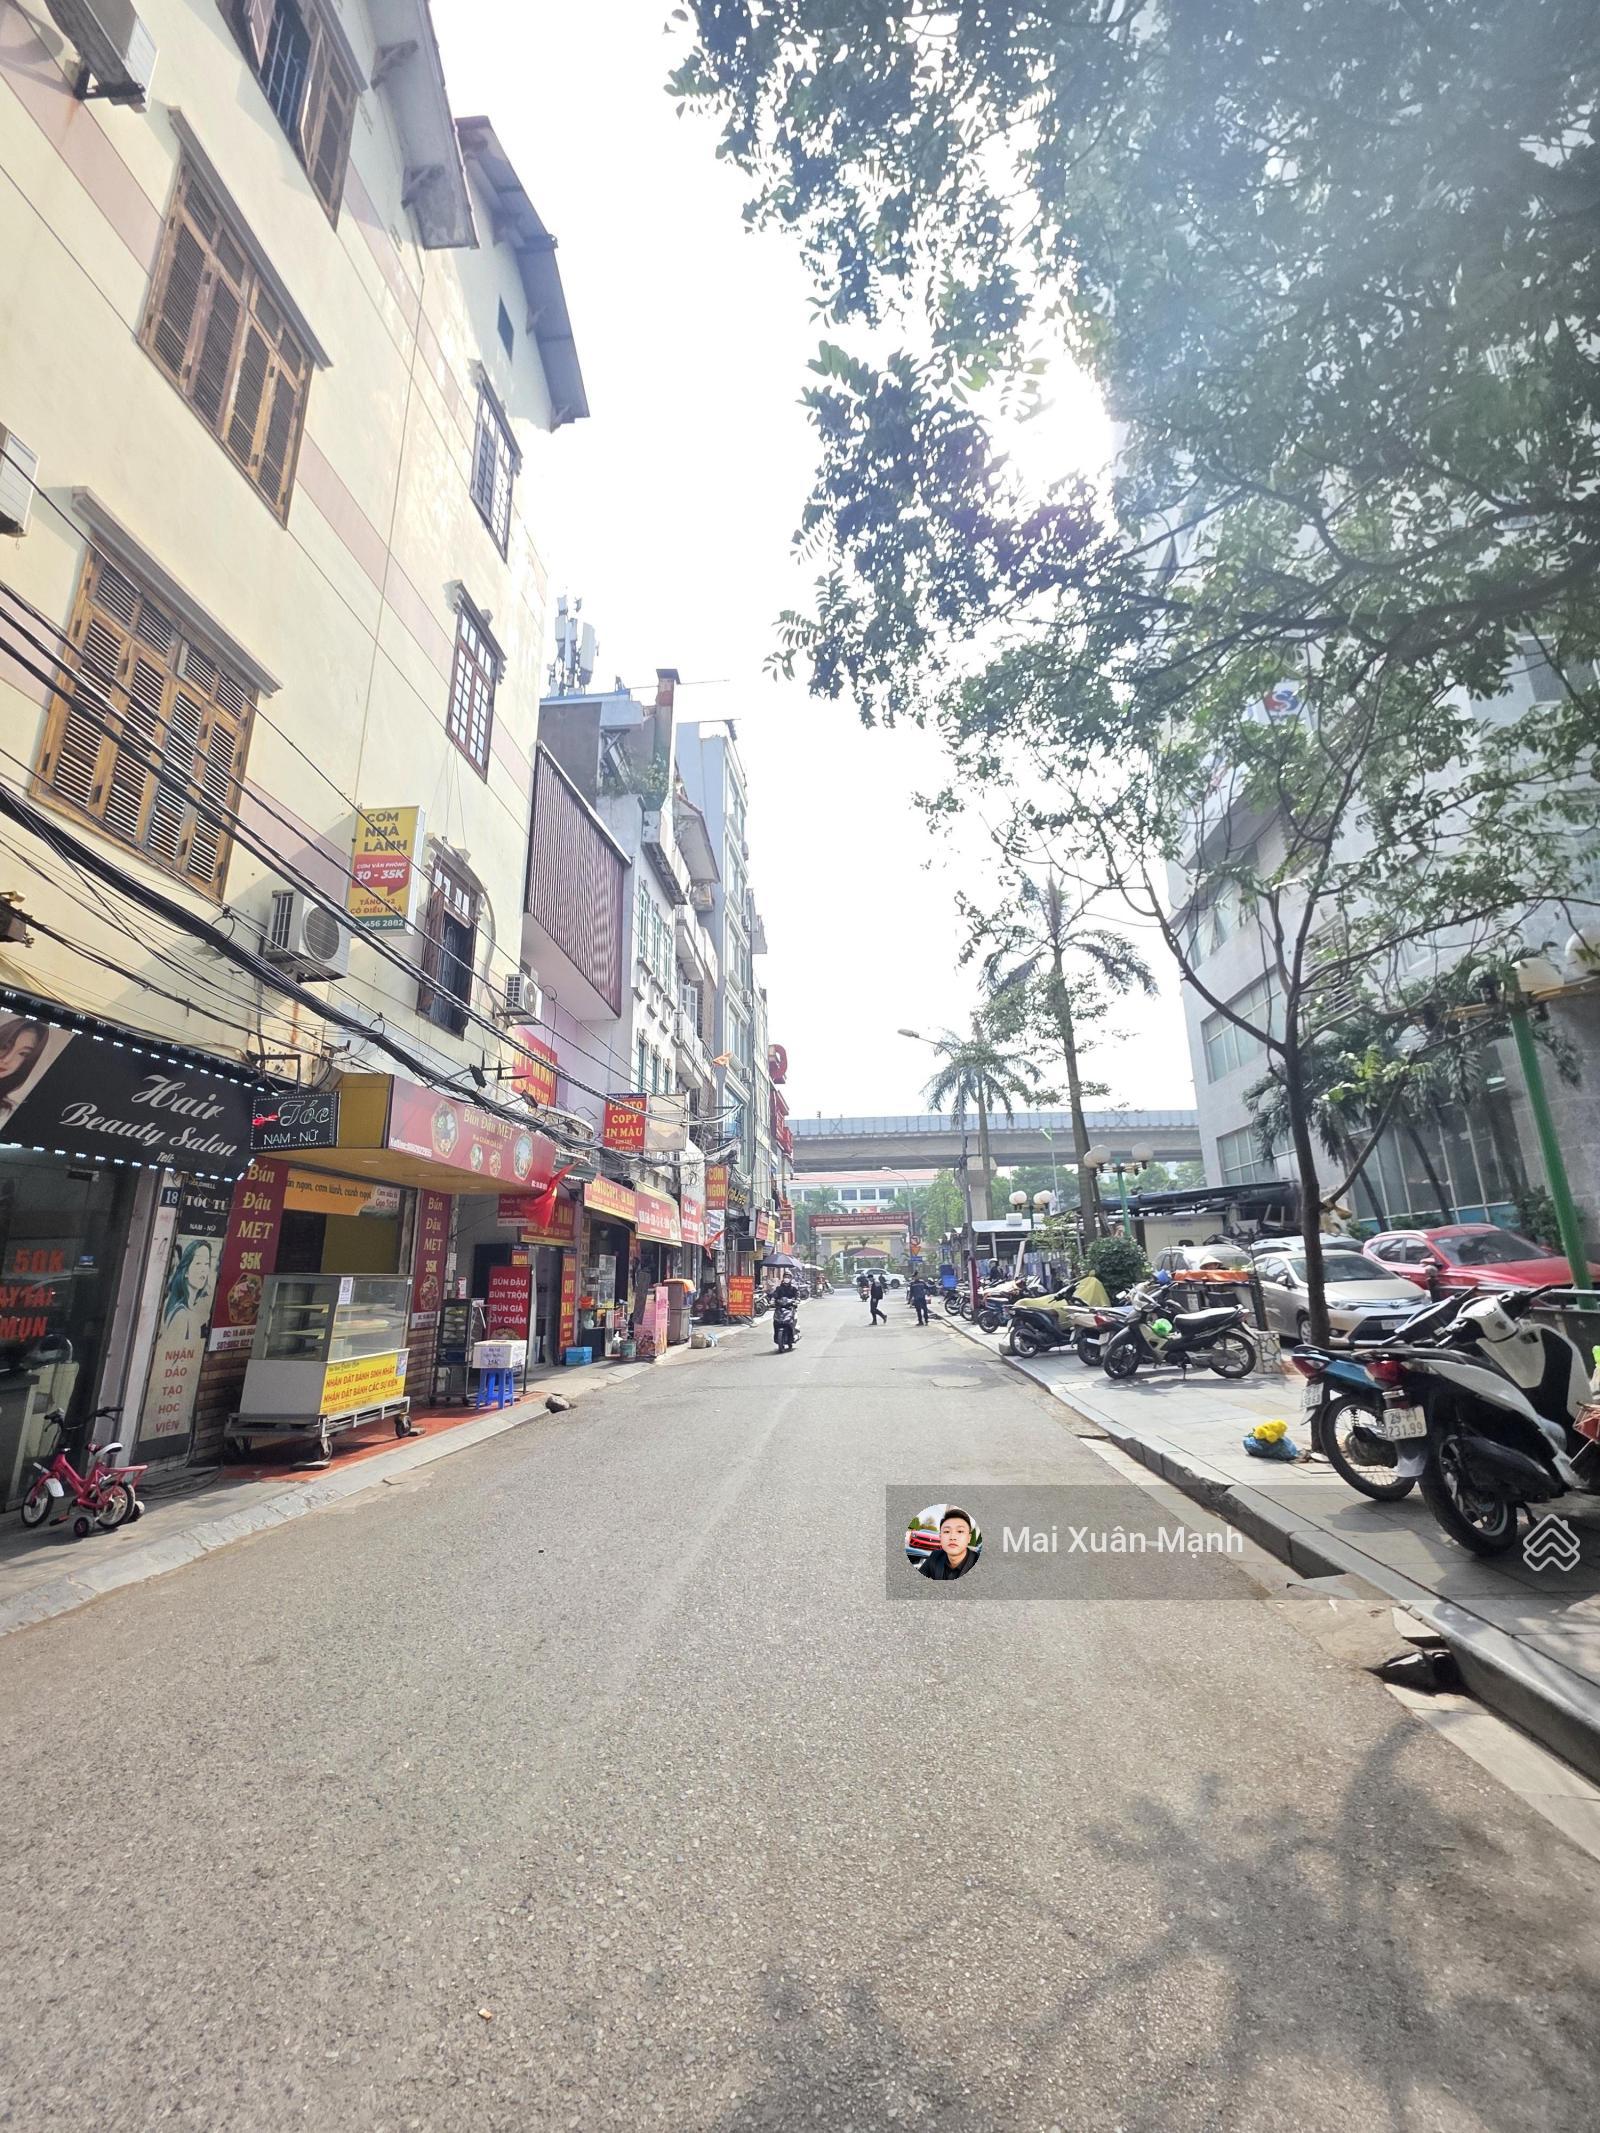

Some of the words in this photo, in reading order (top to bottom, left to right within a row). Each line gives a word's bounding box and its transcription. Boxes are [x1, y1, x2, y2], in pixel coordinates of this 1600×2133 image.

[366, 810, 399, 822] CƠM
[365, 823, 400, 838] NHÀ
[363, 838, 408, 852] LÀNH
[356, 870, 371, 881] 30
[380, 869, 404, 880] 35K
[131, 1074, 225, 1120] Hair
[611, 1114, 639, 1124] COPY
[57, 1102, 167, 1147] Beauty
[168, 1126, 238, 1157] Salon
[263, 1132, 291, 1145] NAM
[299, 1128, 320, 1143] NỮ
[605, 1127, 618, 1138] IN
[619, 1125, 644, 1137] MÀU
[247, 1164, 276, 1184] Bún
[165, 1190, 180, 1204] 18
[185, 1193, 209, 1209] TÓC
[242, 1191, 273, 1216] Đậu
[428, 1197, 443, 1211] Bún
[236, 1220, 274, 1244] MẸT
[423, 1238, 444, 1255] MẸT
[239, 1252, 264, 1270] 35K
[492, 1276, 509, 1286] BÚN
[509, 1277, 527, 1288] ĐẬU
[489, 1289, 506, 1299] BÚN
[506, 1289, 529, 1301] TRỘN
[492, 1302, 509, 1312] BÚN
[503, 1313, 527, 1325] CHẤM
[164, 1347, 195, 1362] NHẬN
[161, 1384, 183, 1398] TẠO
[158, 1402, 180, 1416] HỌC
